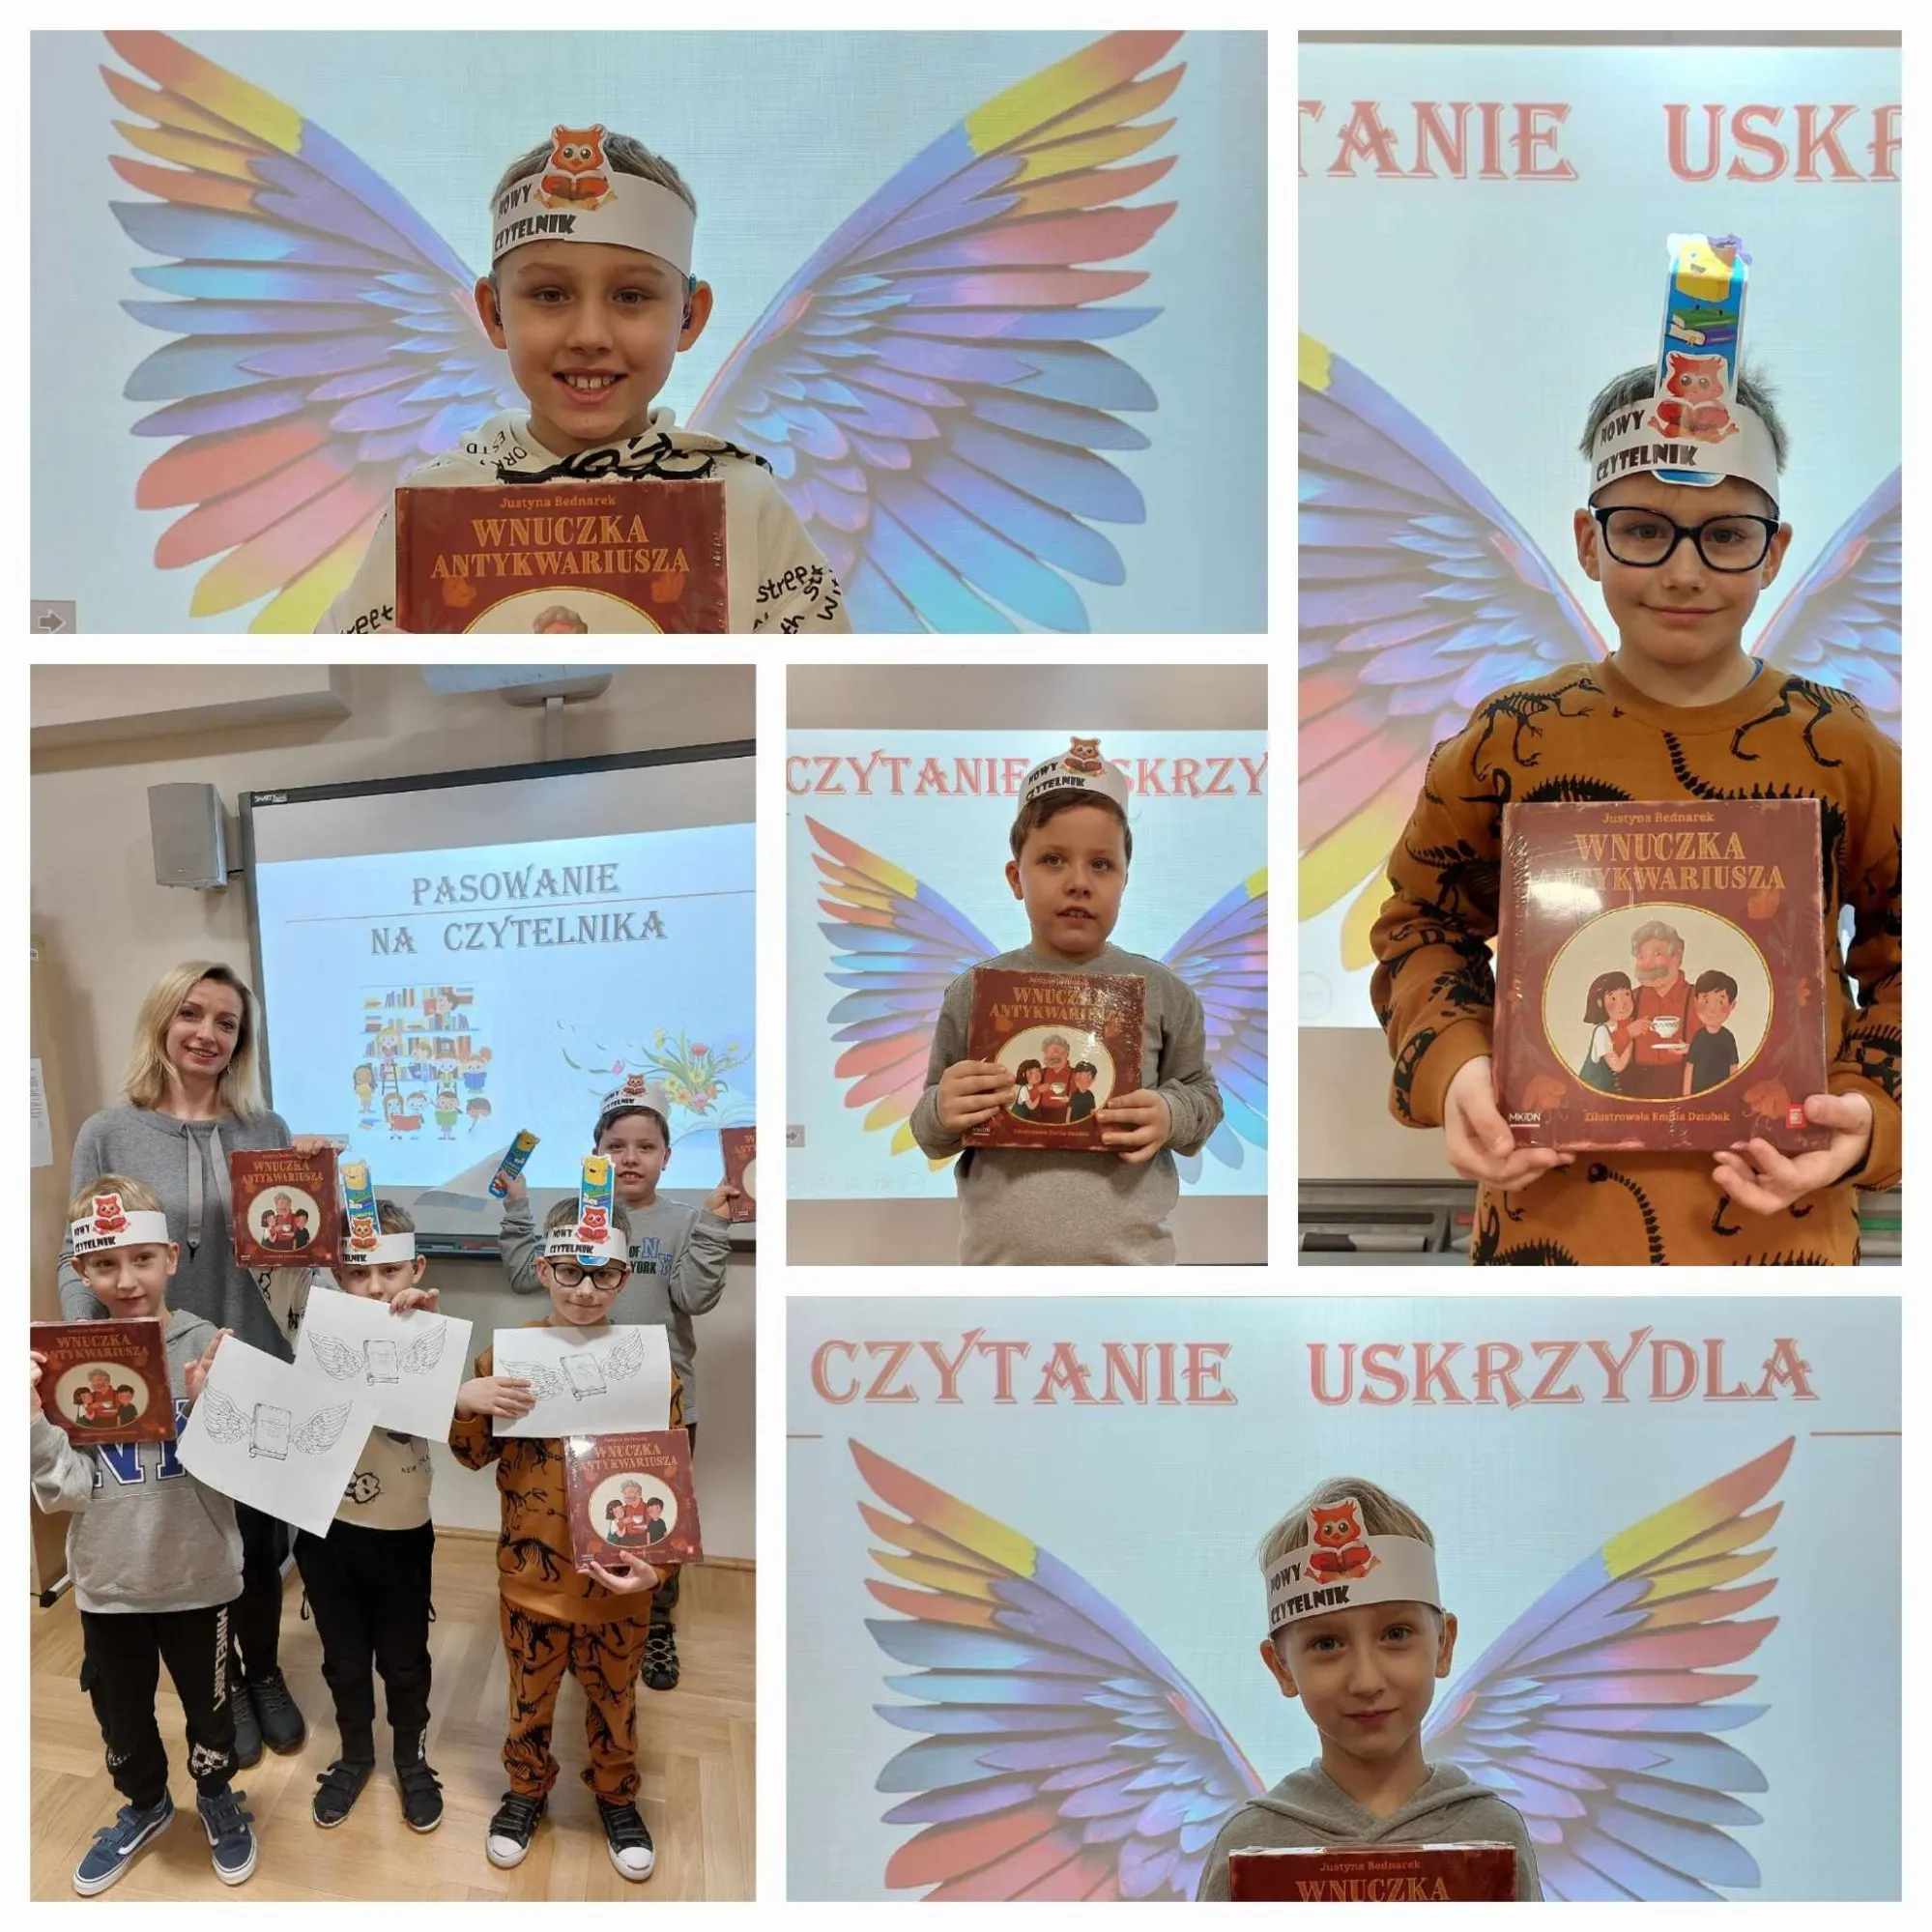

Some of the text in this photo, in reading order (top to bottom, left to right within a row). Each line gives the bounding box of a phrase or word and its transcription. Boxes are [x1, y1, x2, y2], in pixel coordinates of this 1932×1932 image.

[499, 184, 533, 219] NOWY
[494, 213, 577, 252] CZYTELNIK
[1600, 409, 1645, 447] NOWY
[1596, 444, 1698, 482] CZYTELNIK
[500, 495, 616, 510] Justyna Bednarek
[471, 514, 649, 548] WNUCZKA
[431, 548, 690, 580] ANTYKWARIUSZA
[787, 749, 1030, 796] CZYTANIE
[1026, 776, 1085, 800] CZYTELNIK
[1028, 762, 1058, 785] NOWY
[1603, 812, 1715, 825] Justyna Bednarek
[1573, 831, 1746, 863] WNUCZKA
[412, 862, 620, 906] PASOWANIE
[370, 910, 668, 955] NA CZYTELNIKA
[1688, 1111, 1731, 1122] Dziubak
[253, 1161, 309, 1171] WNUCZKA
[57, 1334, 132, 1348] WNUCZKA
[810, 1325, 1820, 1411] CZYTANIE USKRZYDLA
[594, 1443, 662, 1458] WNUCZKA
[1270, 1562, 1302, 1595] NOWY
[1270, 1585, 1351, 1625] CZYTELNIK
[1320, 1860, 1421, 1873] Justyna Bednarek
[1295, 1877, 1451, 1902] WNUCZKA
